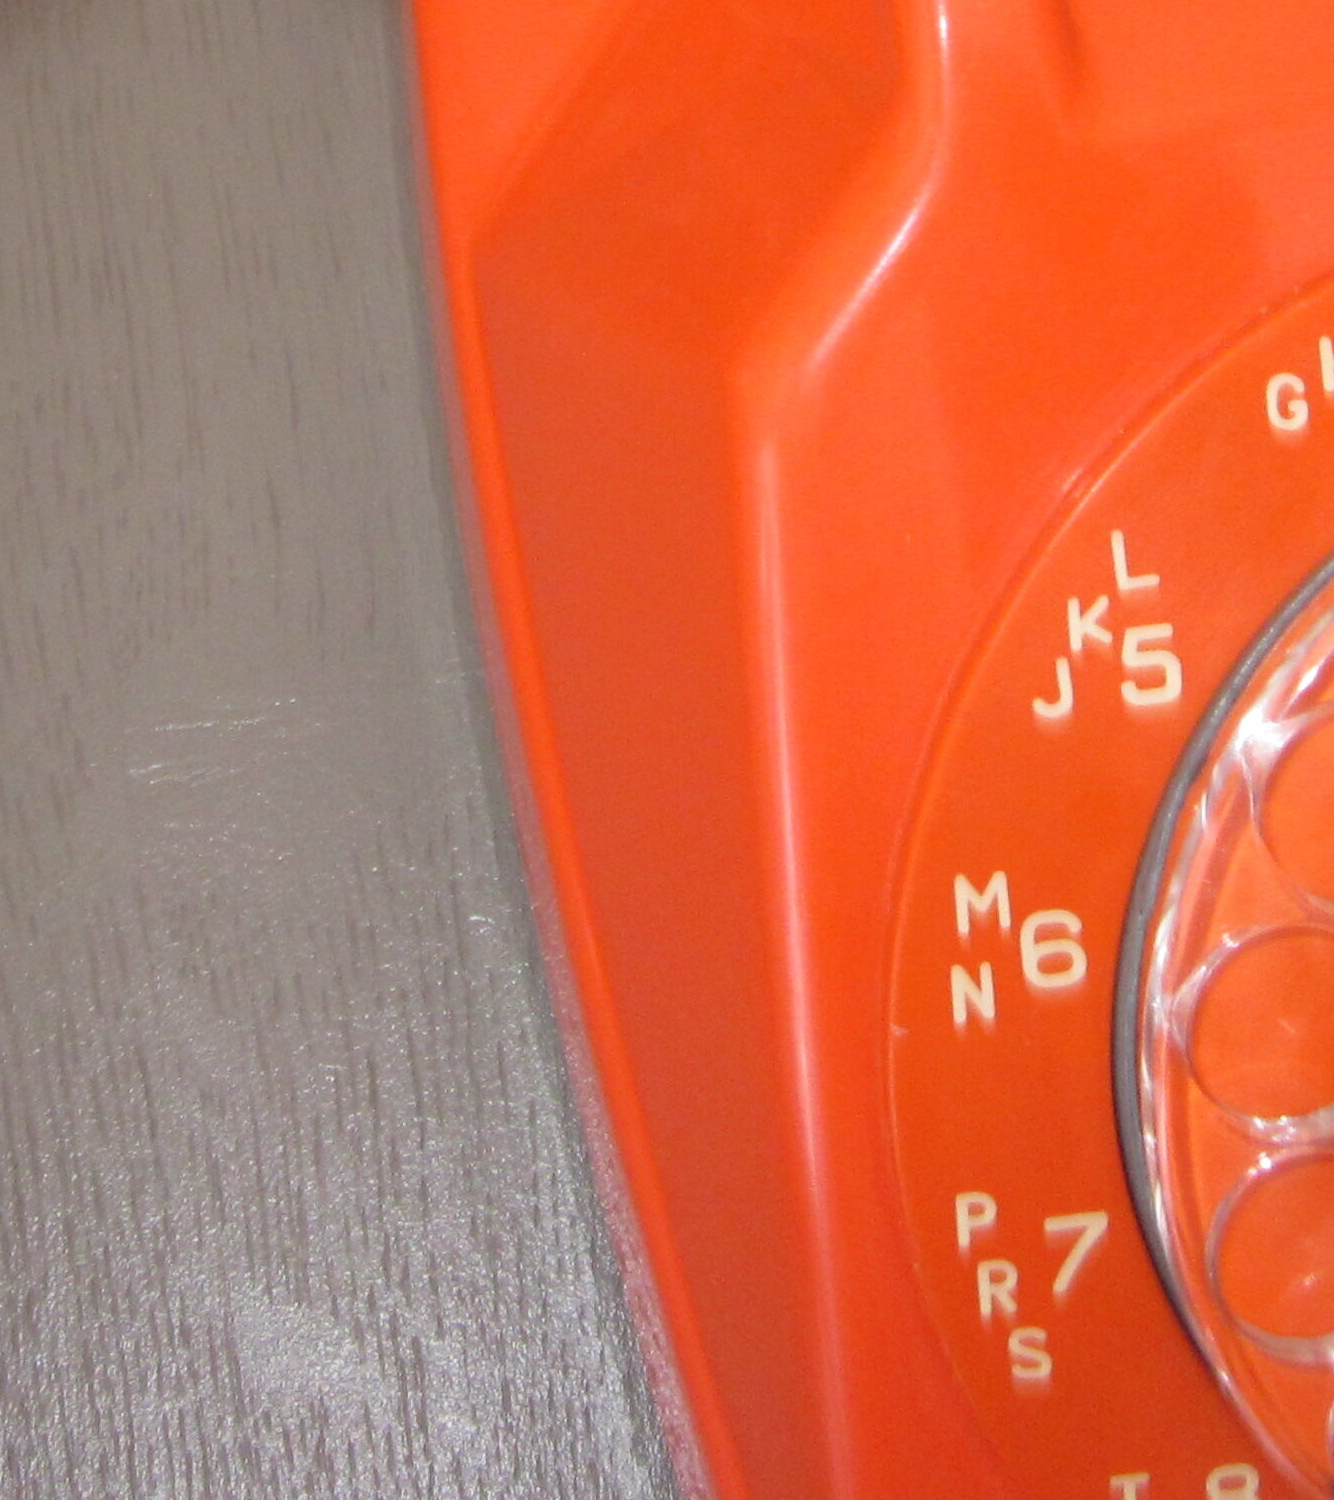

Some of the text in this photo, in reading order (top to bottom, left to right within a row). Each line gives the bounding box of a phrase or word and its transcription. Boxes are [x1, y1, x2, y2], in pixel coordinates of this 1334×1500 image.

[1121, 623, 1182, 707] 5
[1019, 909, 1088, 989] 6
[1045, 1211, 1108, 1295] 7
